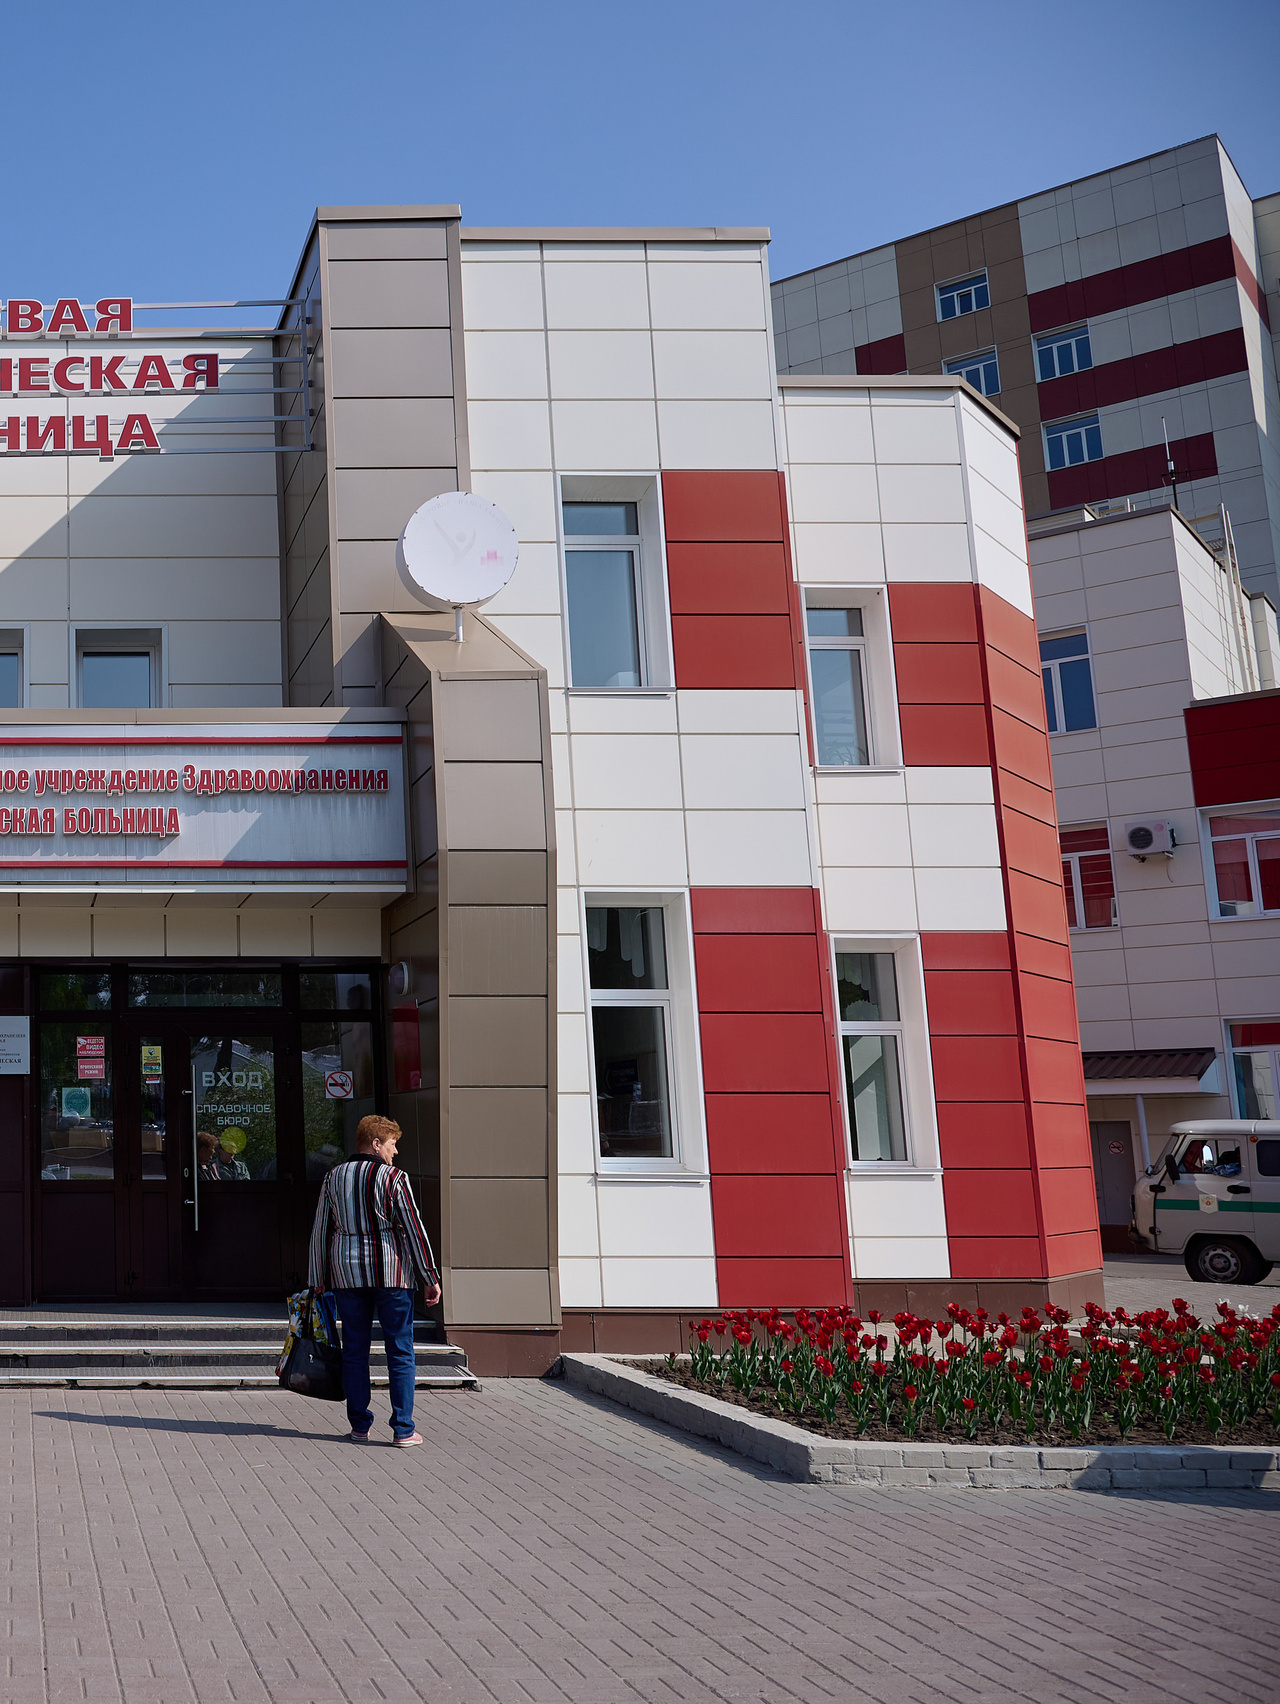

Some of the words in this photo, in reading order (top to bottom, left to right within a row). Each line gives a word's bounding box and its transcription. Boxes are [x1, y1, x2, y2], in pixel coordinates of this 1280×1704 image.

[33, 767, 179, 796] учреждение
[181, 764, 390, 797] Здравоохранения
[62, 806, 181, 838] БОЛЬНИЦА
[202, 1072, 263, 1090] ВХОД
[196, 1104, 271, 1113] СПРАВОЧНОЕ
[217, 1116, 250, 1125] БЮРО
